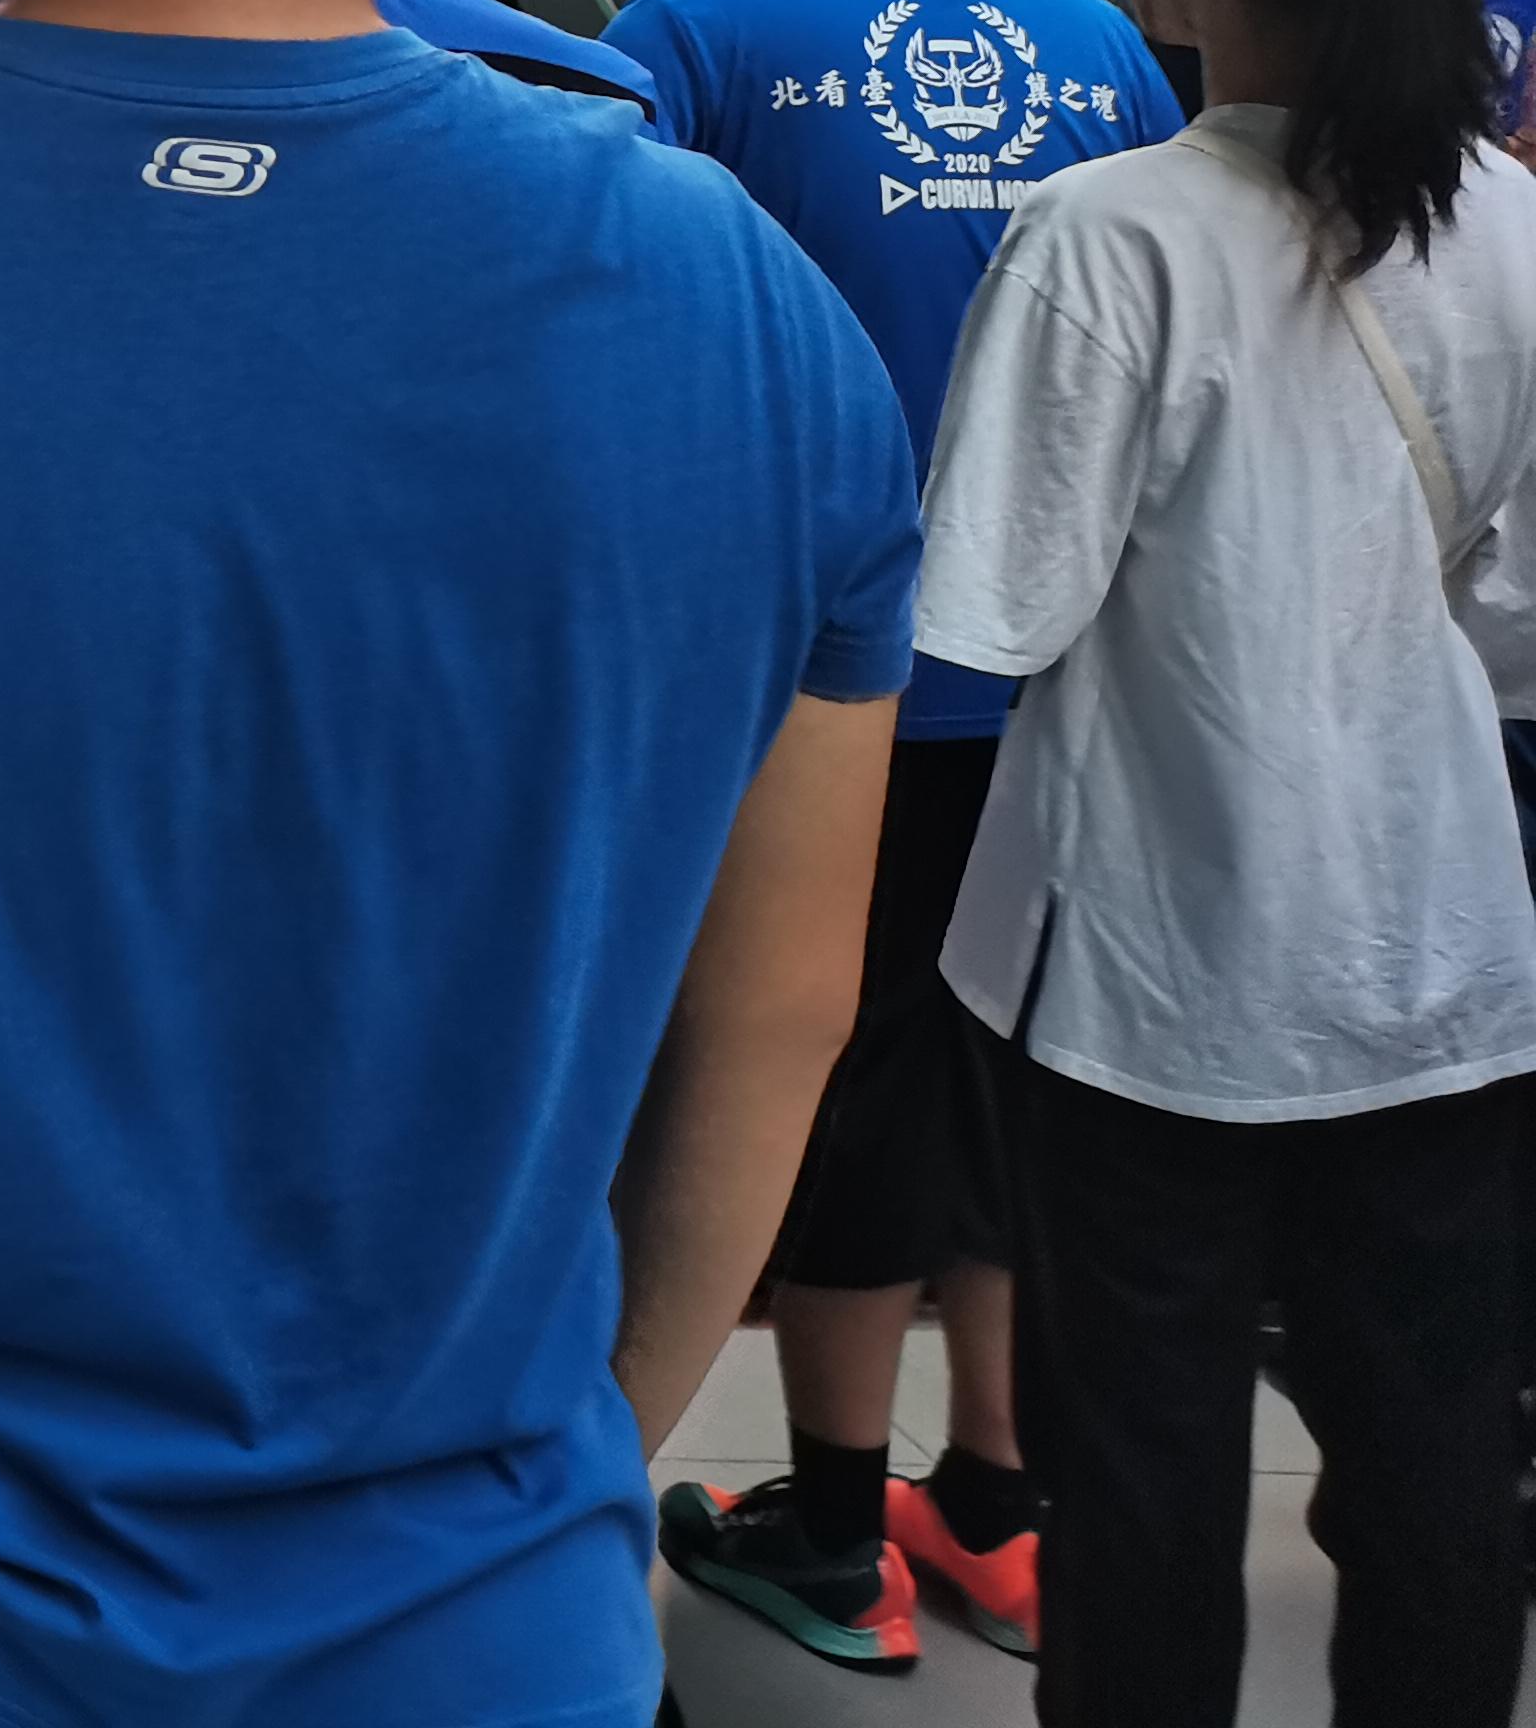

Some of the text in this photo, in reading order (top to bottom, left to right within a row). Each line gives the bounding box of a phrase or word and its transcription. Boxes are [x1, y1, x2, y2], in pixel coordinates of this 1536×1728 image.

[943, 153, 991, 174] 2020
[920, 178, 1038, 210] CURVA NO
